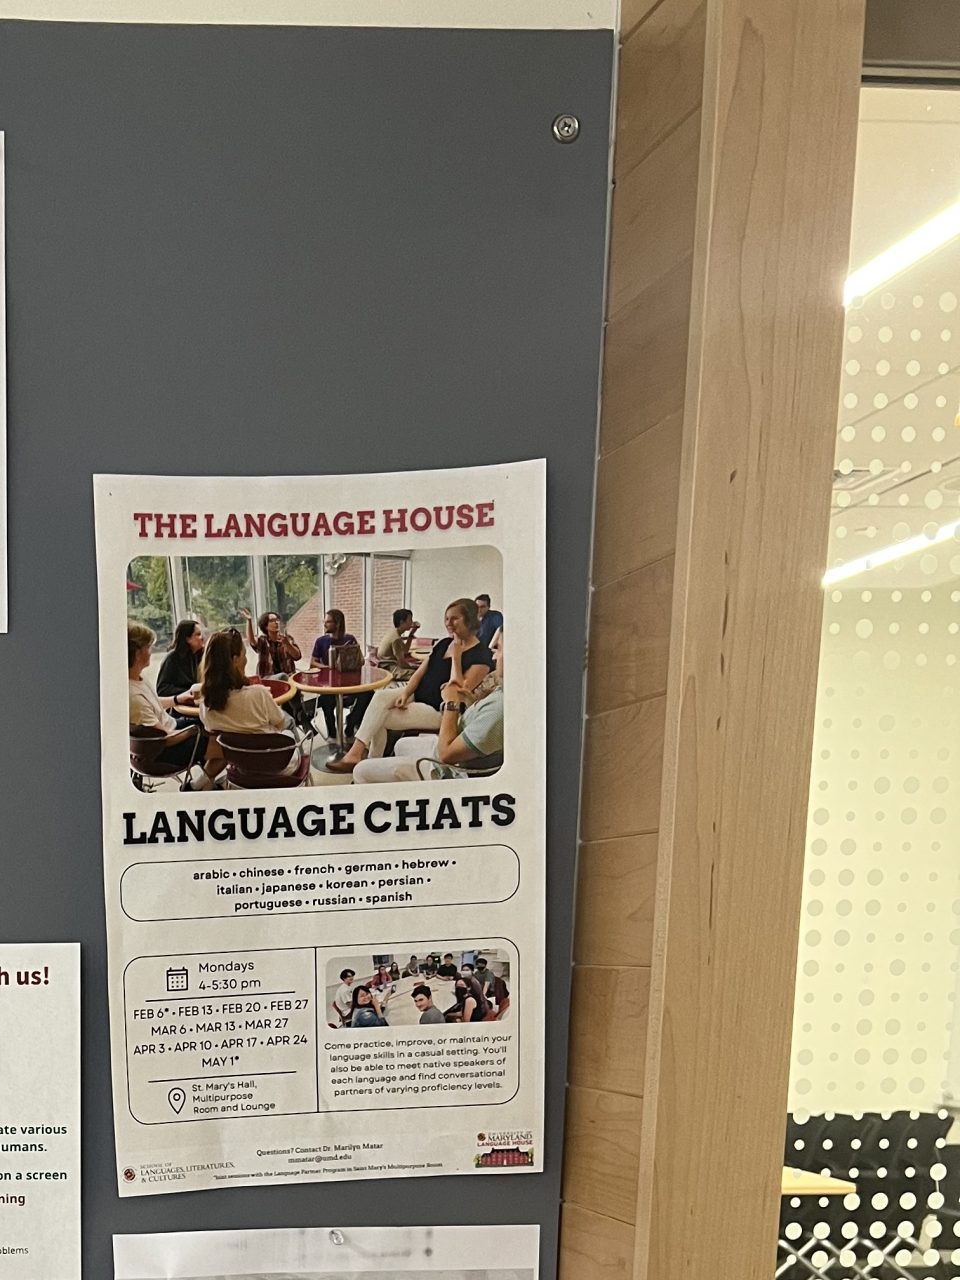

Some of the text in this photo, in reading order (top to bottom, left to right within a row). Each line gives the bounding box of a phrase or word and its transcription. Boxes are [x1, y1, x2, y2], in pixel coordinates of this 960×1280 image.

[133, 501, 494, 538] THE LANGUAGE HOUSE
[122, 792, 515, 845] LANGUAGE CHATS
[192, 858, 449, 880] arabic chinese french german hebrew
[216, 874, 423, 895] italian japanese korean persian
[234, 890, 412, 912] portuguese russian spanish
[16, 965, 49, 985] us!
[198, 960, 254, 973] Mondays
[198, 978, 261, 990] 4-5:30 pm
[15, 1171, 22, 1180] a
[25, 1171, 67, 1180] screen
